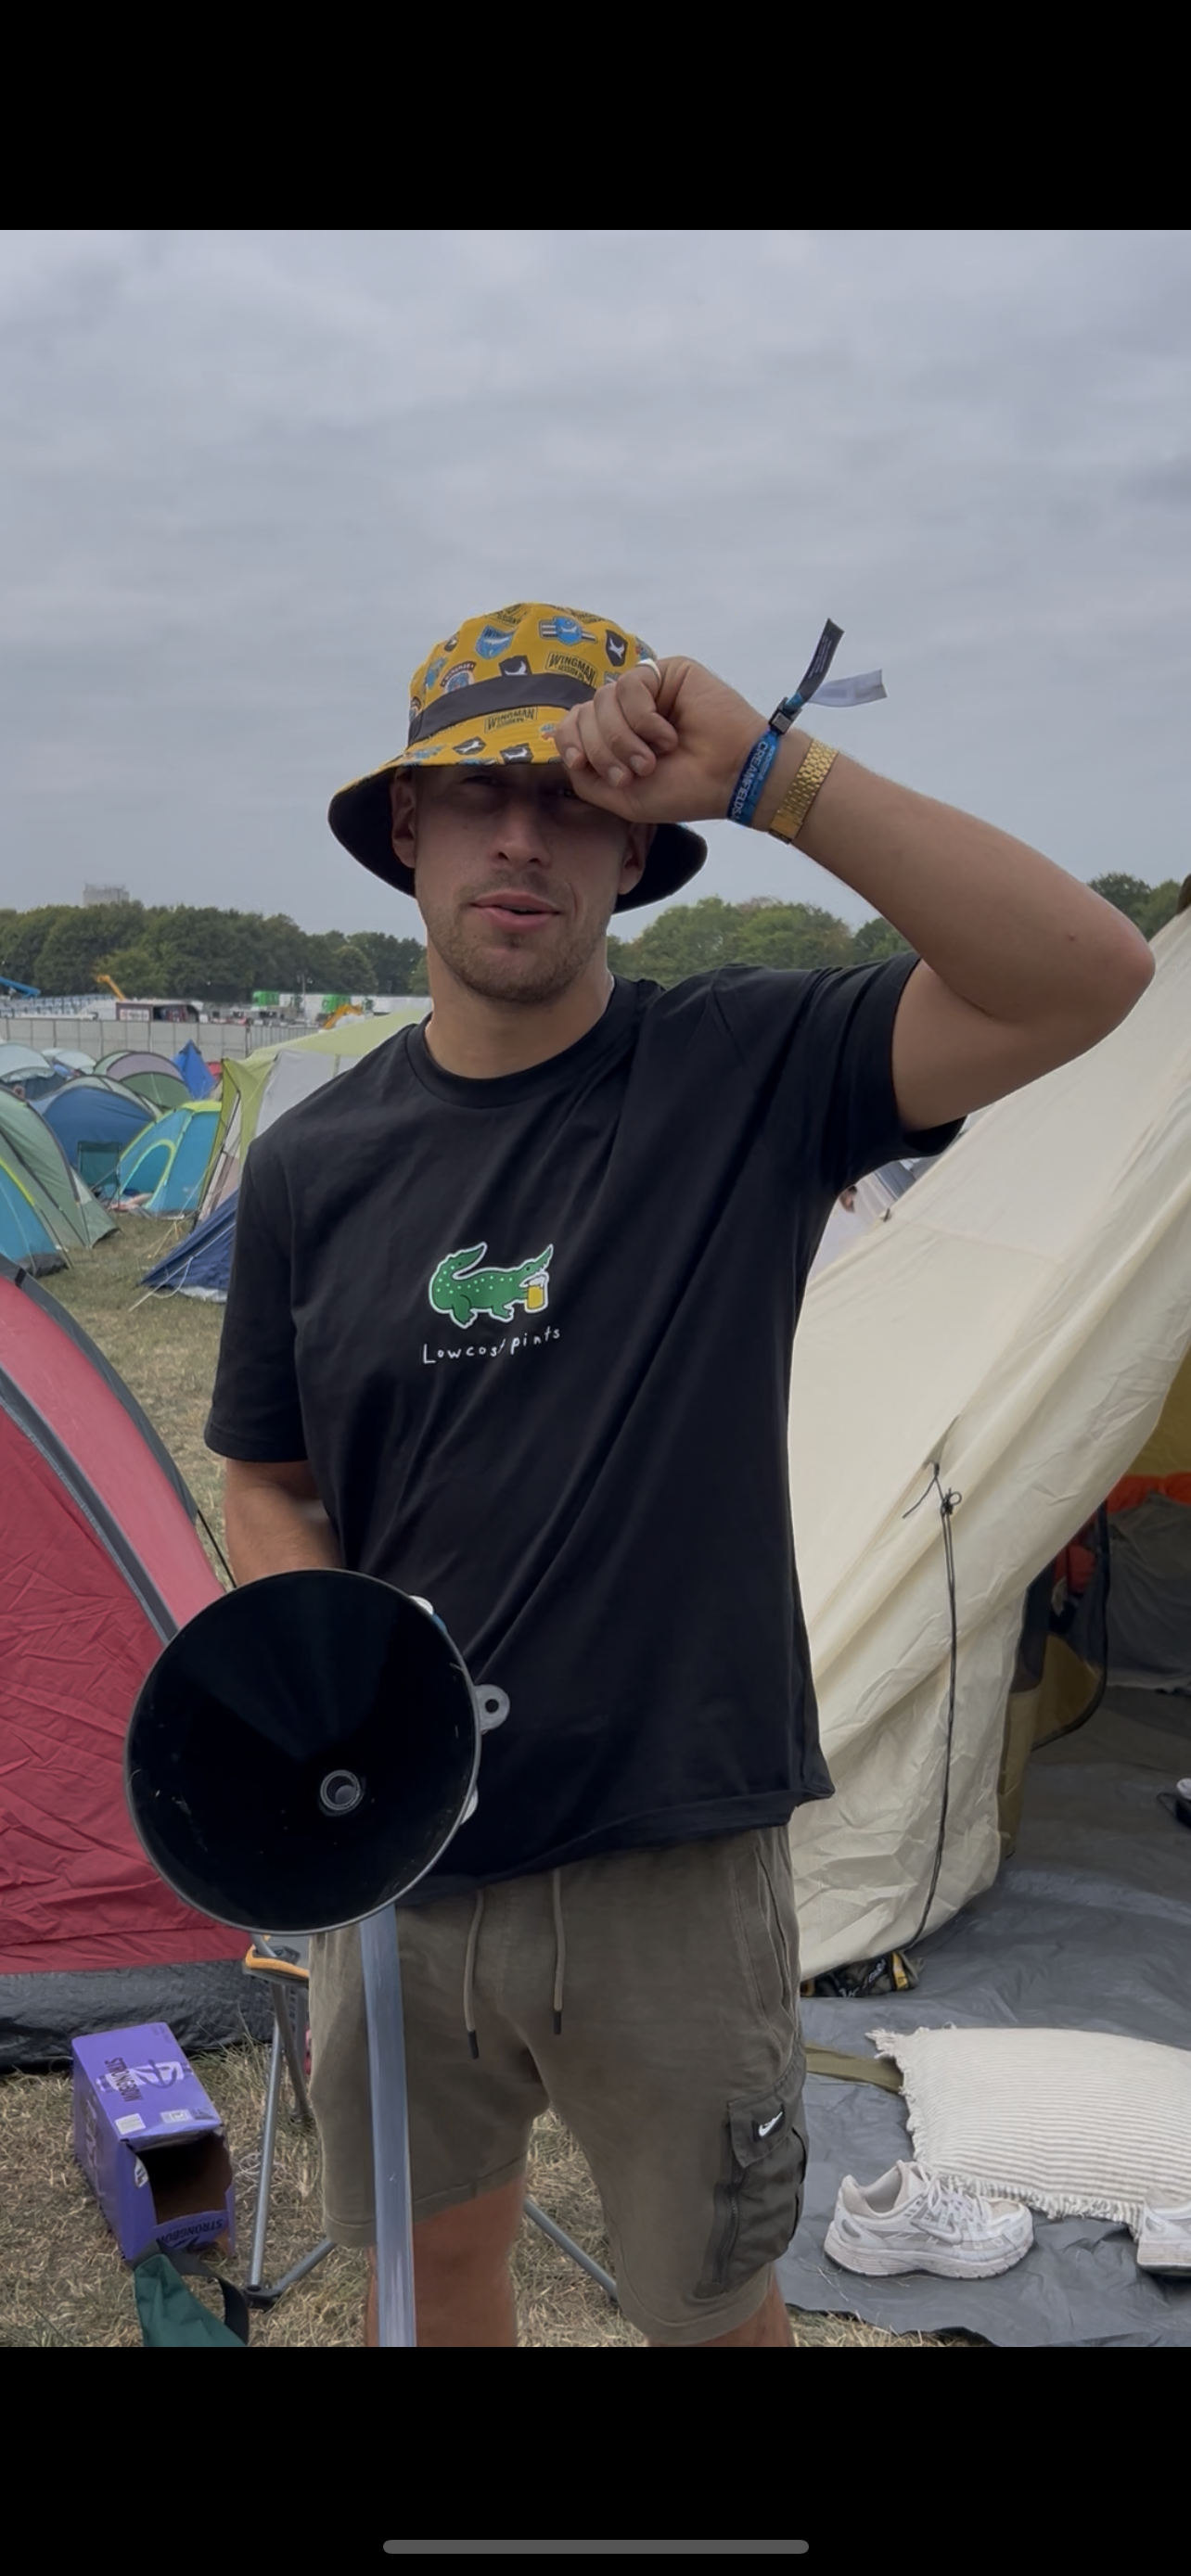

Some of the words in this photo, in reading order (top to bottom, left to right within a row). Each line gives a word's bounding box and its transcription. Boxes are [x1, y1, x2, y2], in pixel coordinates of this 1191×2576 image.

[548, 654, 596, 686] WINGMAN
[487, 708, 535, 731] WINGMAN
[731, 742, 768, 815] CREAMFIELDS
[510, 1326, 560, 1355] pints
[105, 2057, 144, 2102] STRONGBOW
